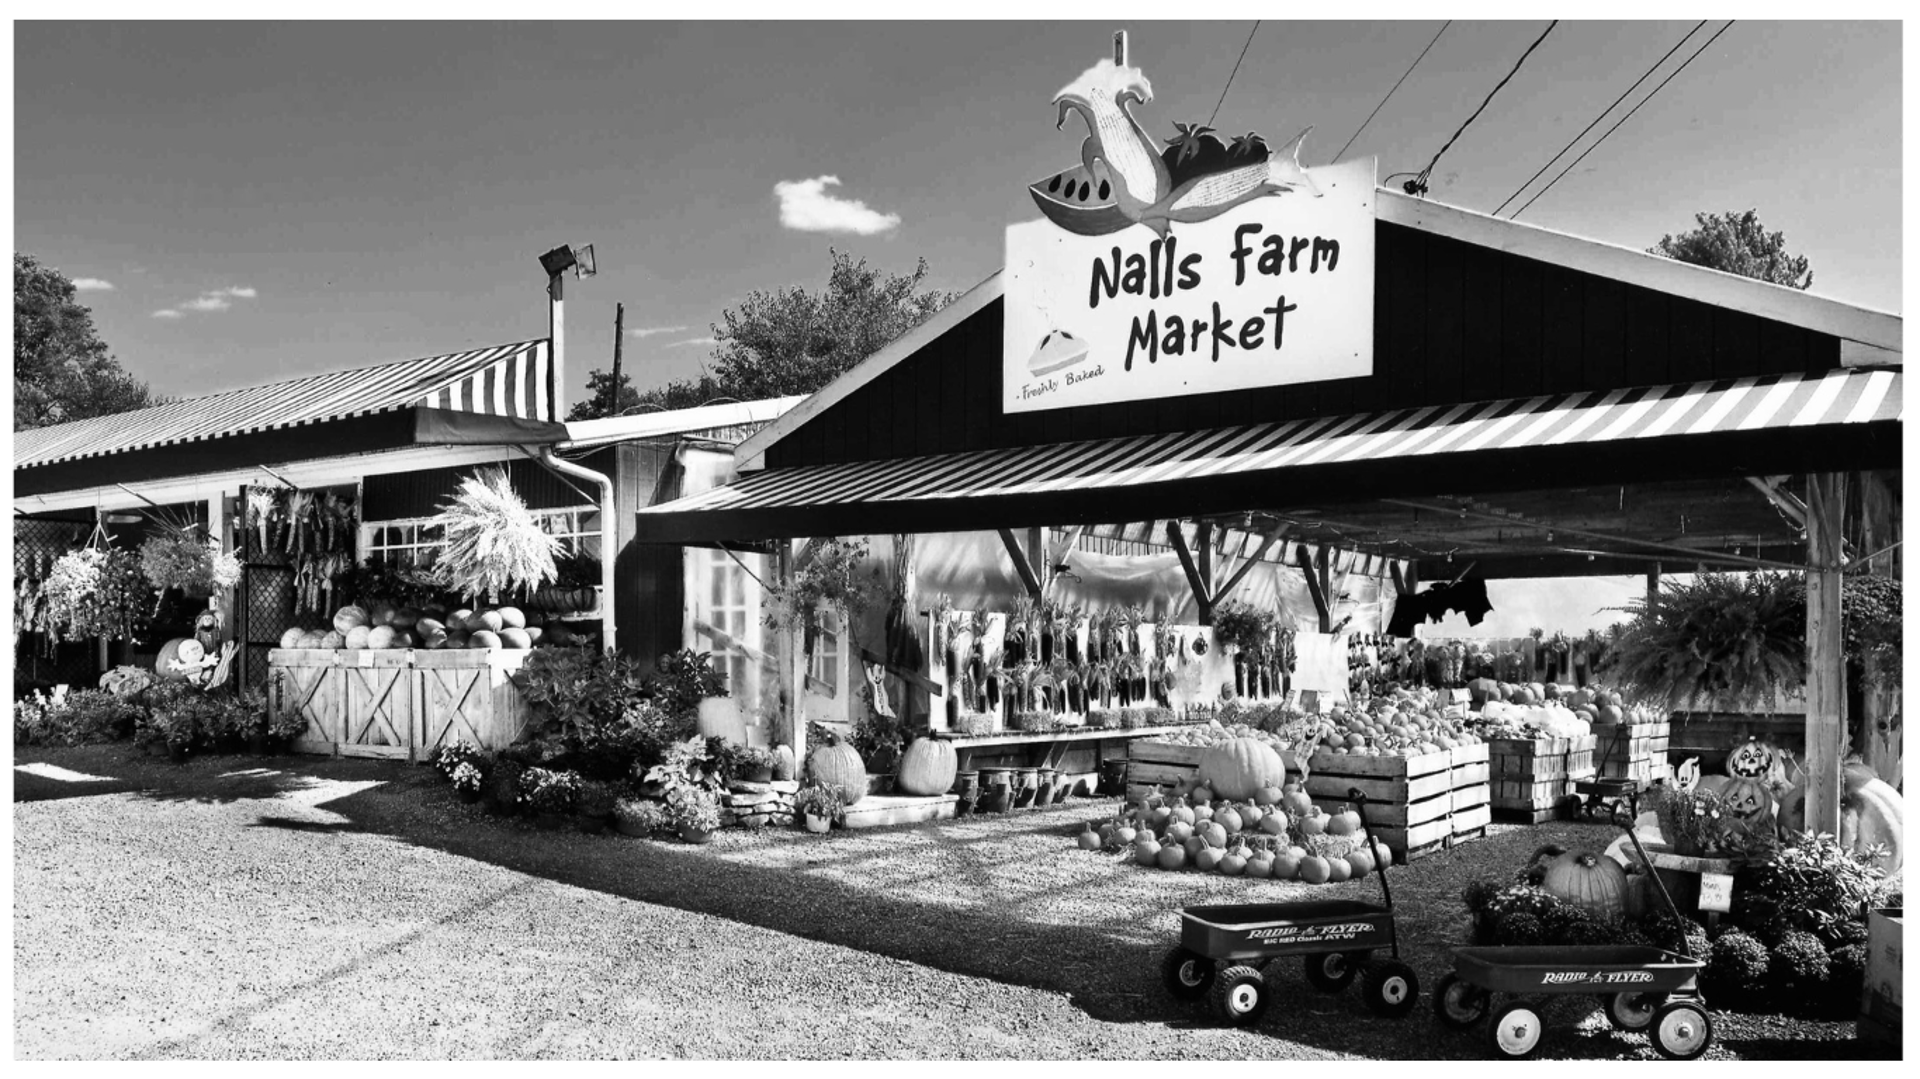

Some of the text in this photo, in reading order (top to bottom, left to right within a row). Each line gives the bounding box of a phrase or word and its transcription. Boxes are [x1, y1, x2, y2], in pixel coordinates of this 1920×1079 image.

[1089, 223, 1340, 308] Nalls Farm
[1124, 295, 1297, 372] Market
[1022, 365, 1105, 400] Freshly Baked
[1245, 922, 1374, 940] RADIO FLYER
[1541, 970, 1654, 985] RADIO FLYER
